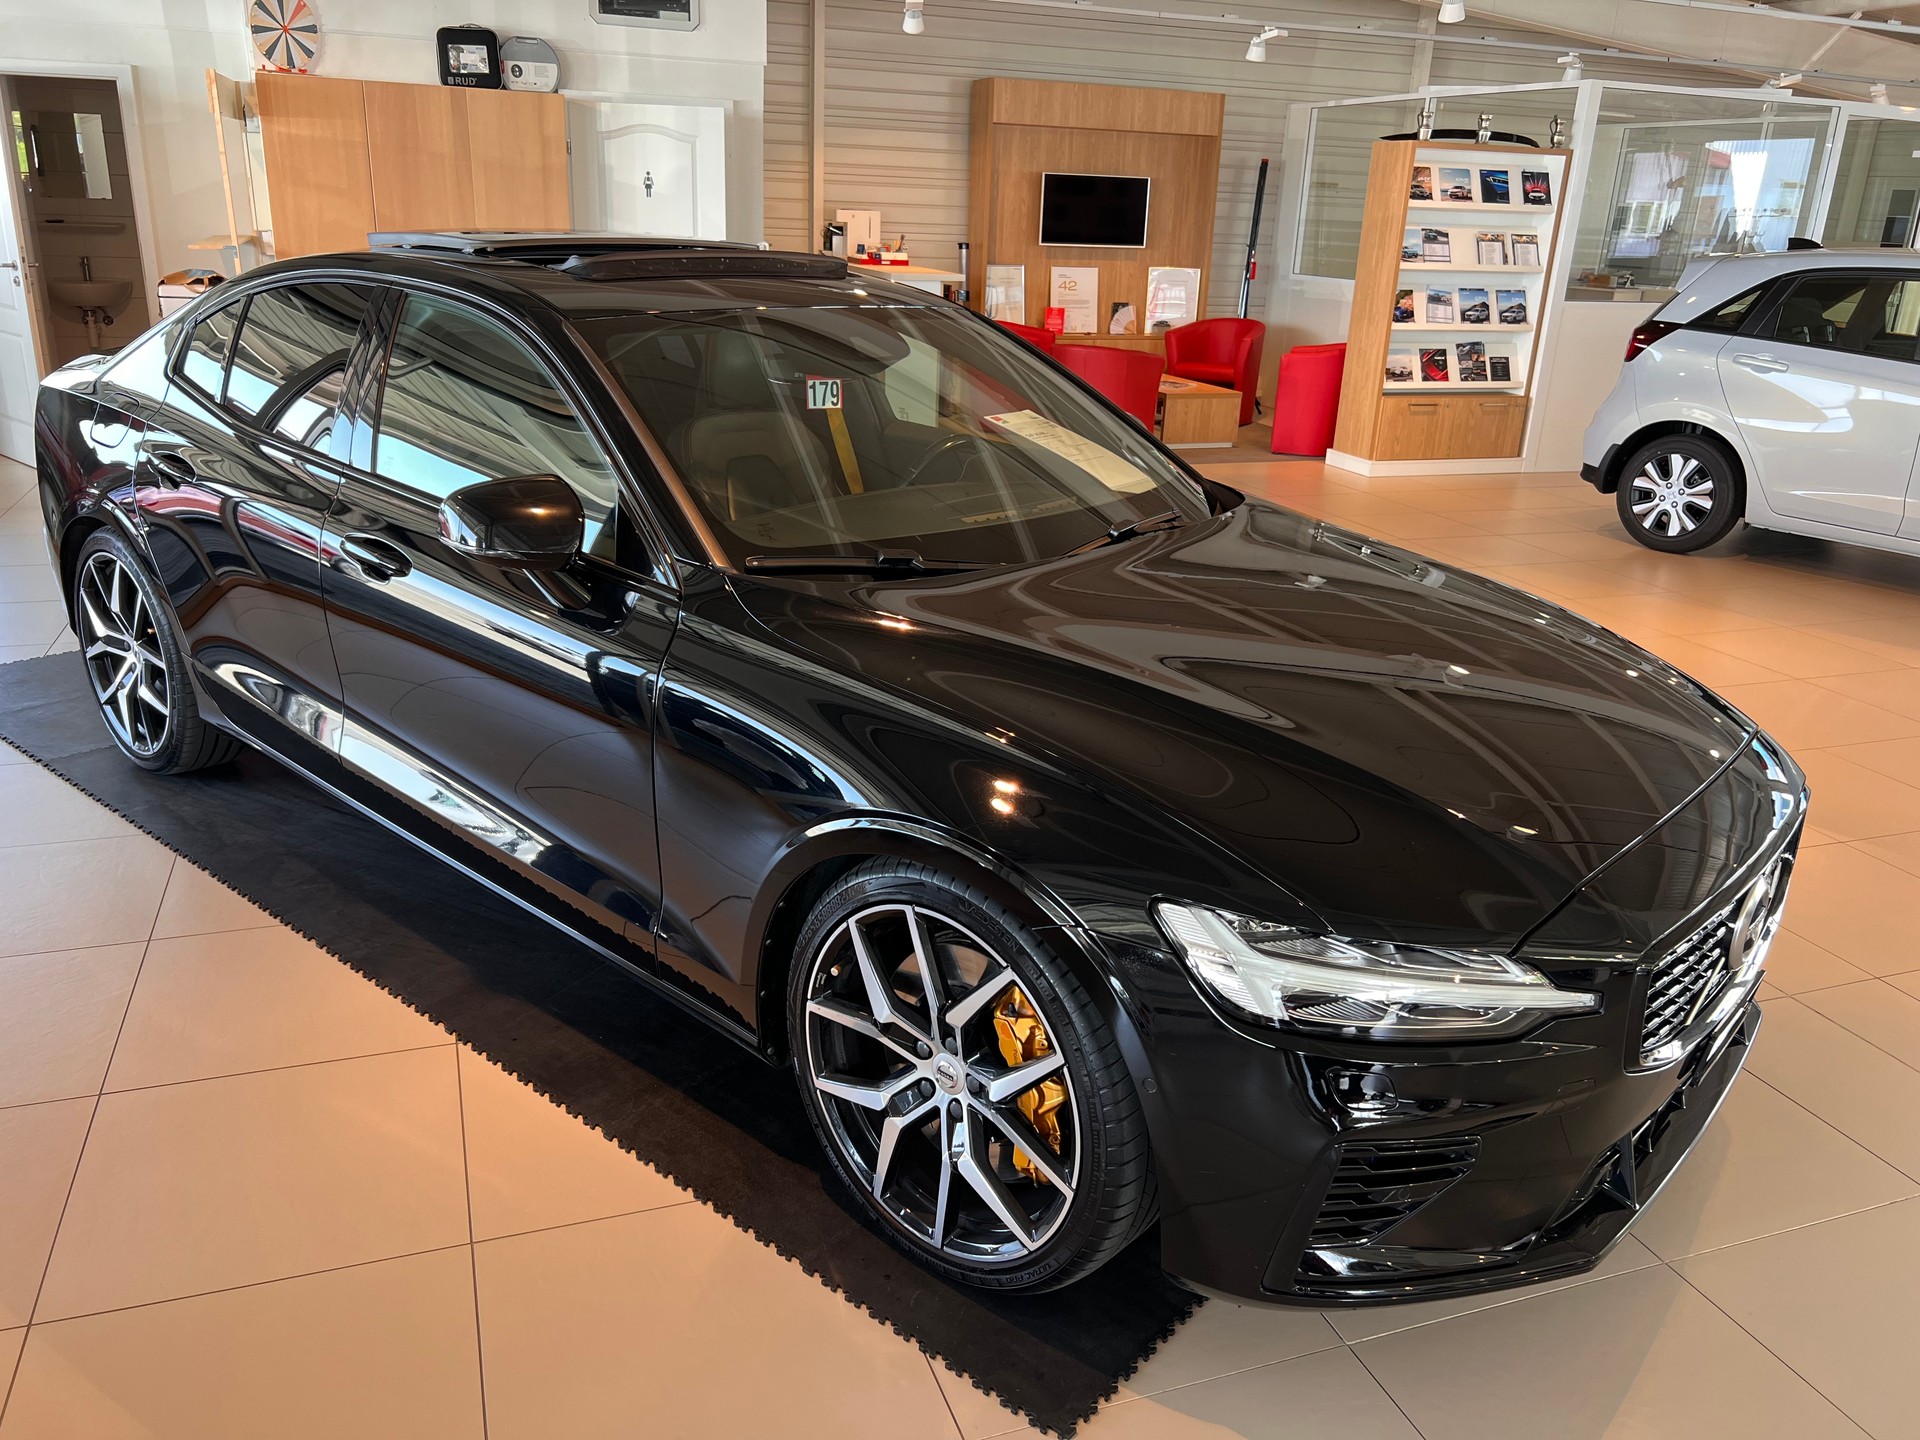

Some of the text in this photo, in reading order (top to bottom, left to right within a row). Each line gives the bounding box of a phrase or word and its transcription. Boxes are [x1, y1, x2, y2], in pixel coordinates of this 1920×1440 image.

[455, 77, 476, 86] RUD
[1058, 280, 1077, 291] 42
[809, 381, 840, 407] 179
